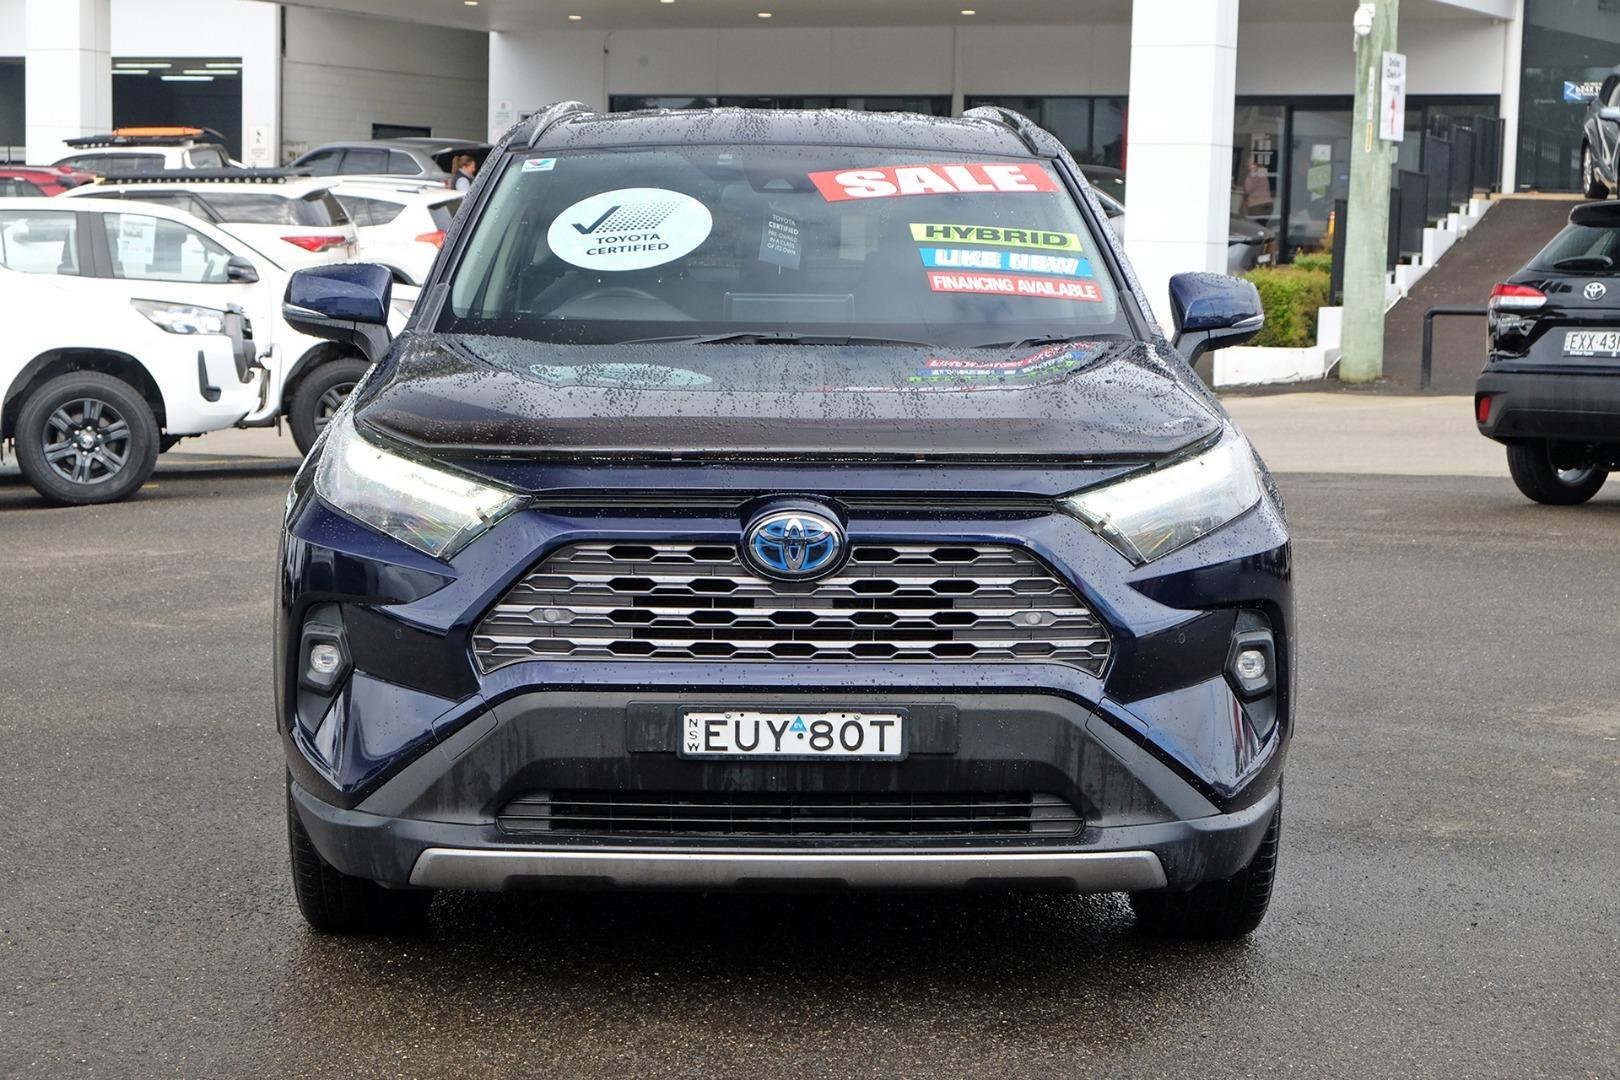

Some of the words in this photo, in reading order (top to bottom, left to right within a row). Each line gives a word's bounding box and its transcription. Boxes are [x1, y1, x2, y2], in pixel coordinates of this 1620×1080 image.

[834, 165, 1038, 198] SALE
[768, 221, 799, 235] CERTIFIED
[772, 213, 796, 226] TOYOTA
[596, 233, 661, 245] TOYOTA
[925, 225, 1071, 247] HYBRID
[586, 242, 670, 256] CERTIFIED
[934, 249, 1002, 269] LIKE
[1008, 252, 1079, 275] NEW
[932, 275, 1014, 293] FINANCING
[1017, 280, 1098, 299] AVAILABLE
